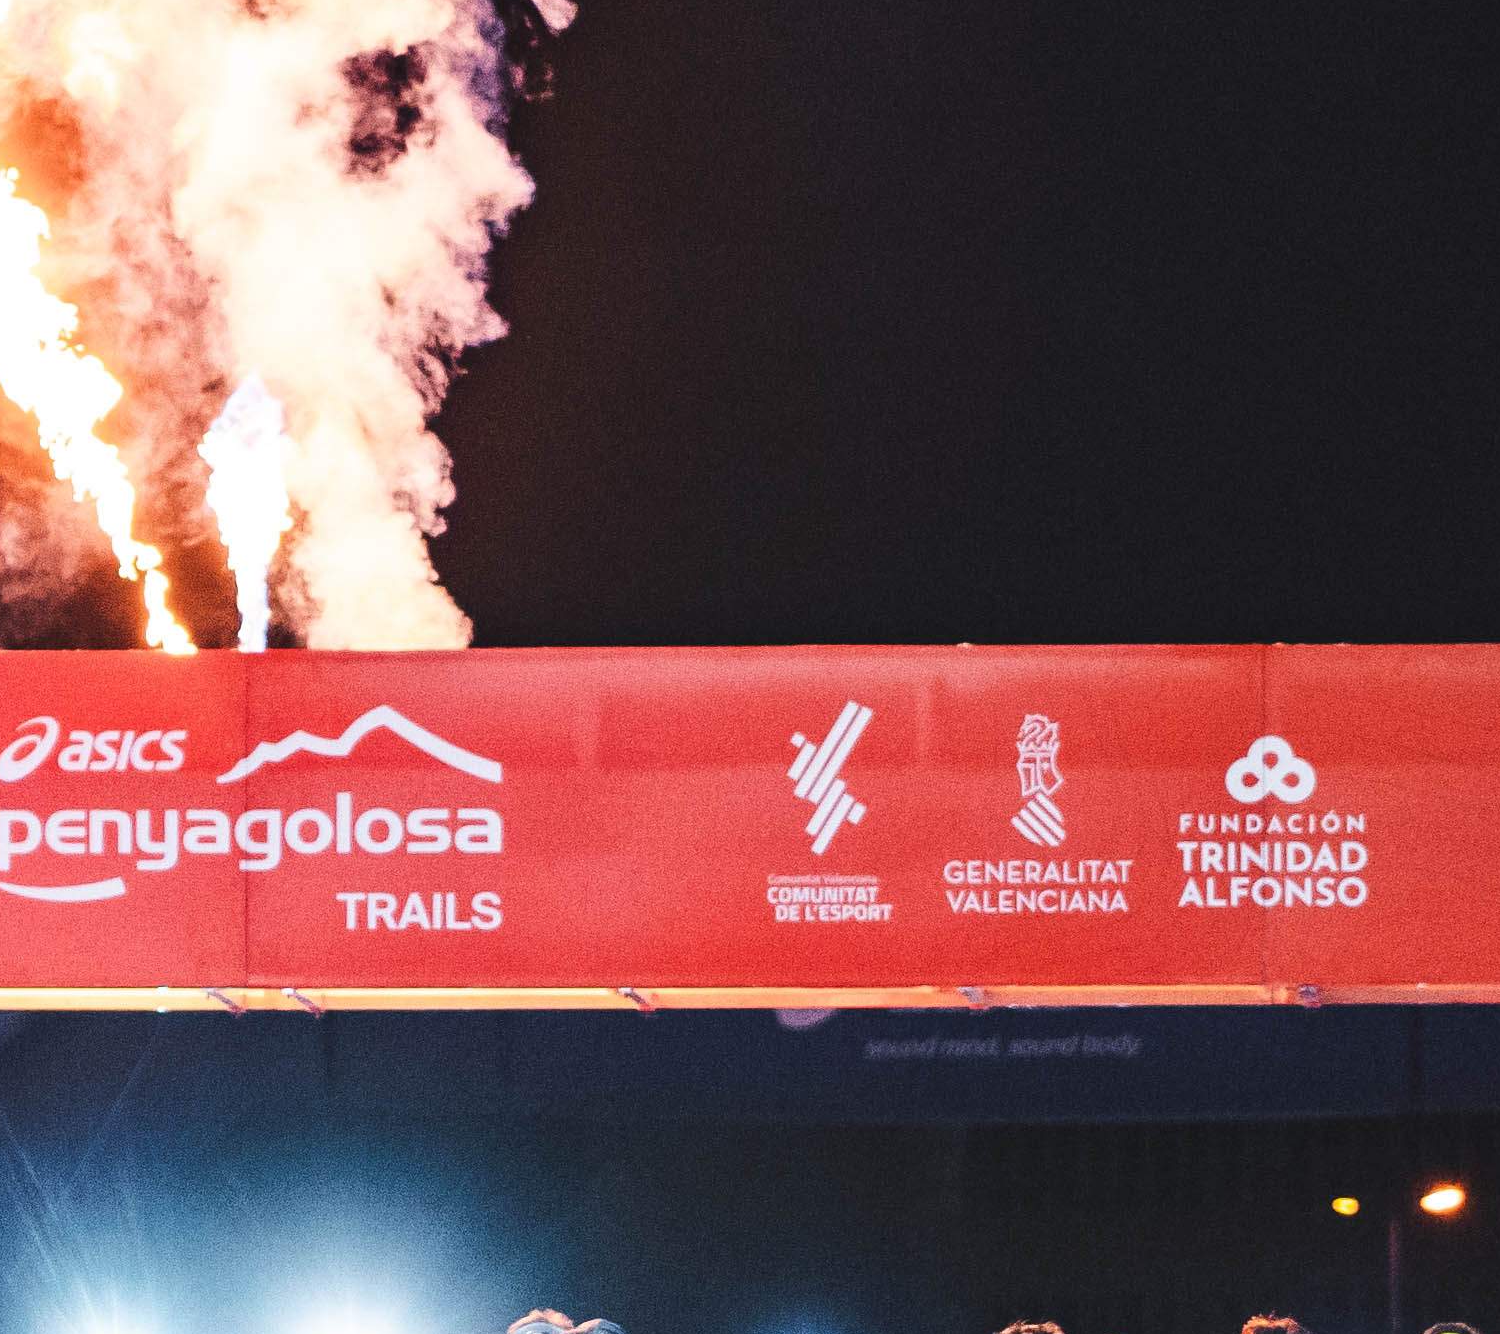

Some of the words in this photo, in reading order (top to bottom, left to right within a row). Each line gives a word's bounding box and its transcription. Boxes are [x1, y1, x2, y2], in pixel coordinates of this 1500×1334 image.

[59, 728, 188, 772] asics
[1179, 809, 1366, 835] FUNDACIÓN
[1177, 841, 1368, 873] TRINIDAD
[943, 859, 1133, 885] GENERALITAT
[767, 886, 878, 904] COMUNITAT
[945, 889, 1129, 914] VALENCIANA
[1178, 877, 1368, 908] ALFONSO
[336, 892, 503, 931] TRAILS
[775, 904, 800, 922] DE
[804, 904, 893, 922] L'ESPORT
